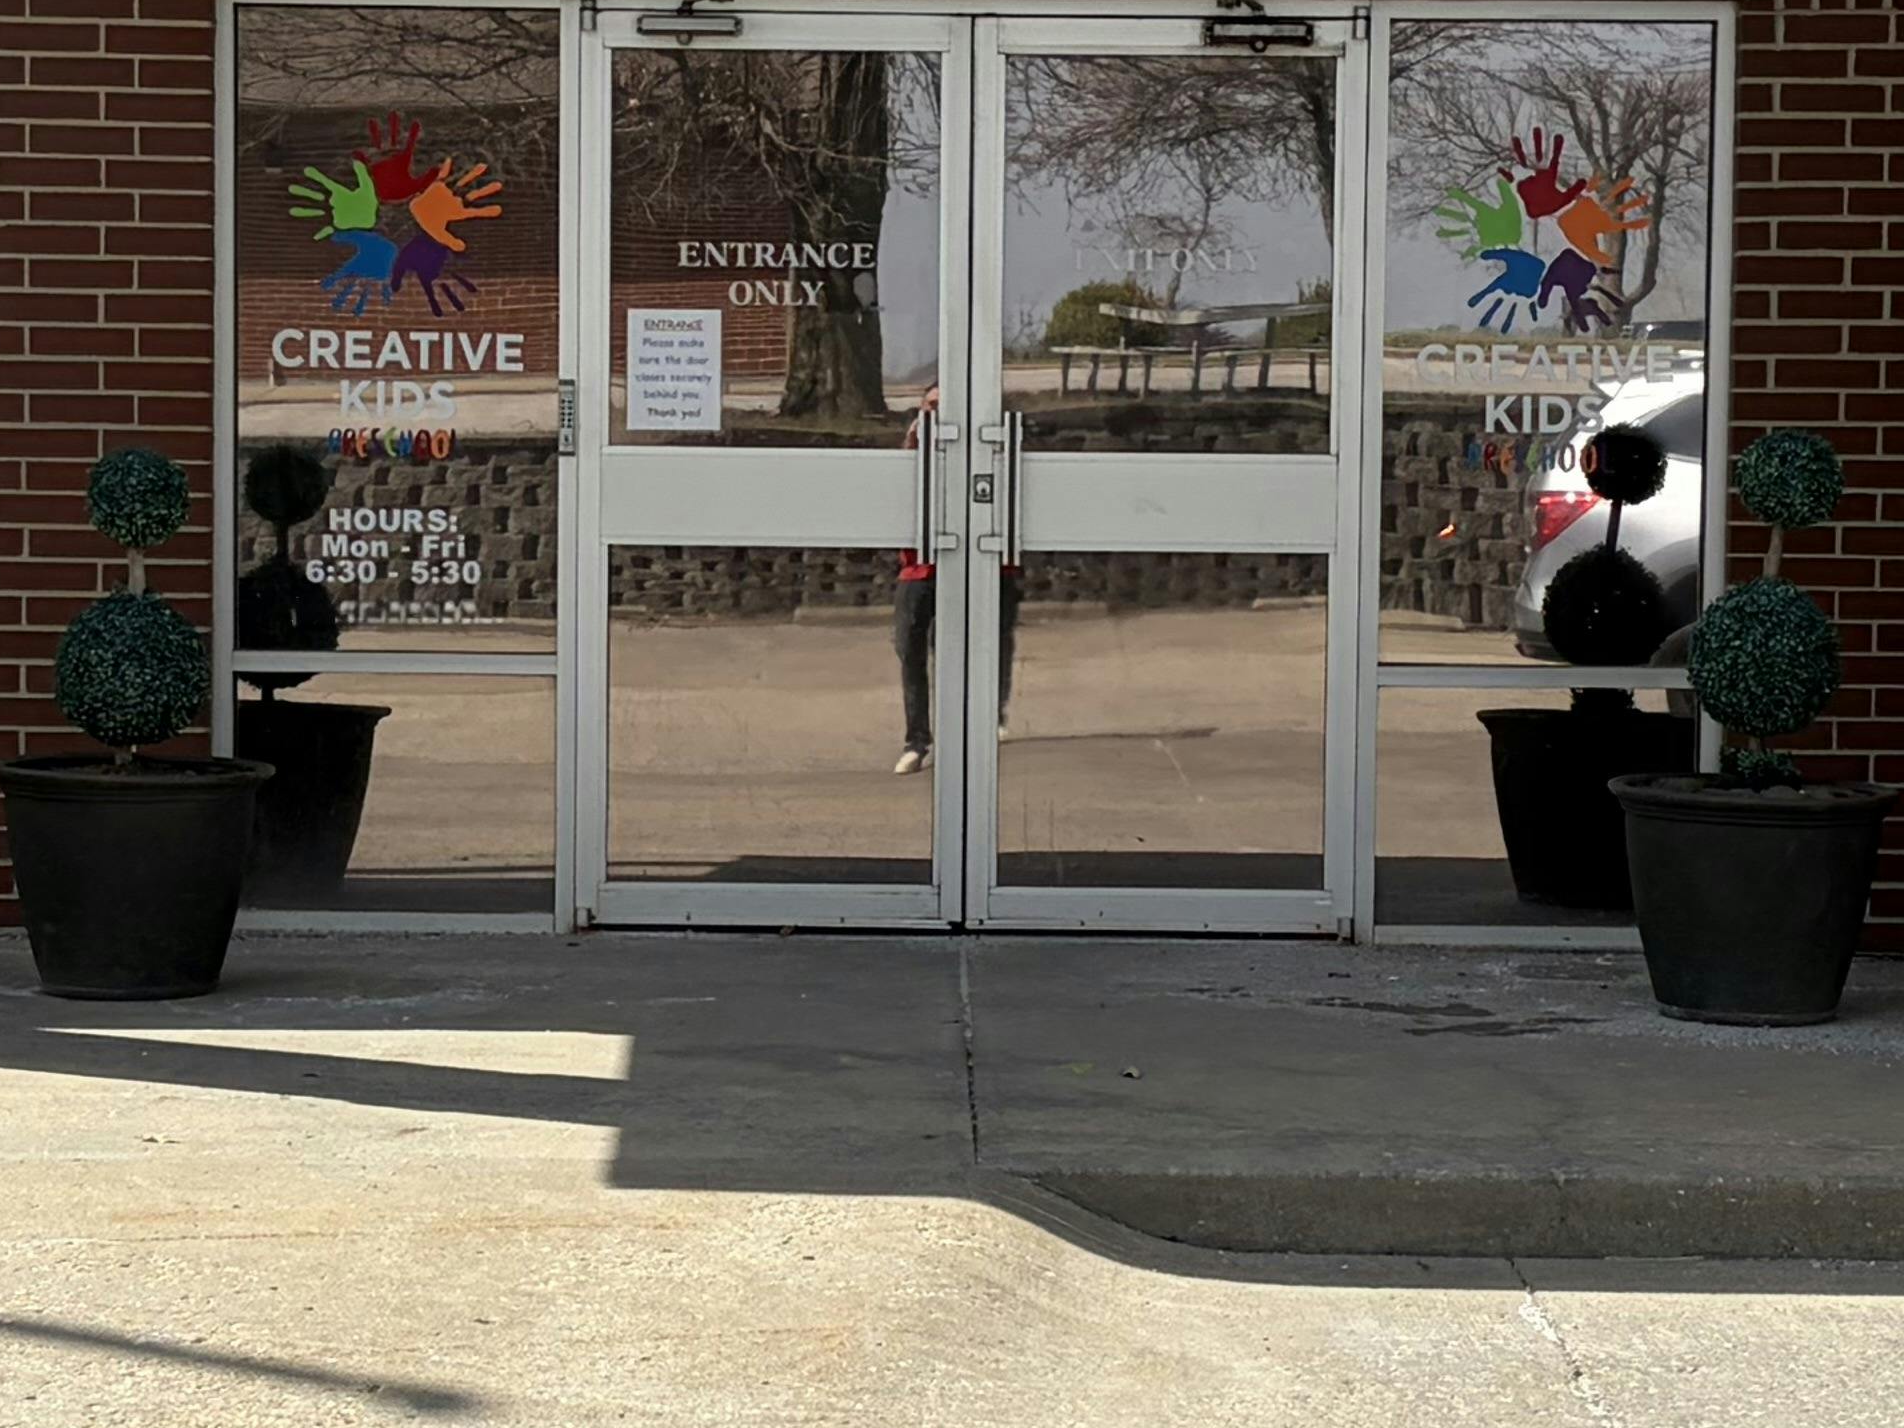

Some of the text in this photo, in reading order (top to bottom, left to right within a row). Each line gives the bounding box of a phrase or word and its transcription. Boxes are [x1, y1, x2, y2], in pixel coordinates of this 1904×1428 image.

[677, 241, 876, 269] ENTRANCE
[728, 280, 825, 307] ONLY
[644, 319, 704, 331] ENTRANCE
[272, 328, 525, 372] CREATIVE
[642, 337, 674, 348] Please
[638, 355, 709, 365] sure the door
[1416, 344, 1674, 383] CREATIVE
[670, 373, 712, 386] securely
[339, 379, 458, 421] KIDS
[643, 389, 678, 400] behind
[647, 406, 677, 418] Thank
[1484, 394, 1605, 434] KIDS
[328, 507, 458, 533] HOURS:
[321, 533, 389, 558] Mon
[421, 534, 467, 559] Fri
[305, 559, 377, 584] 6:30
[410, 560, 482, 585] 5:30
